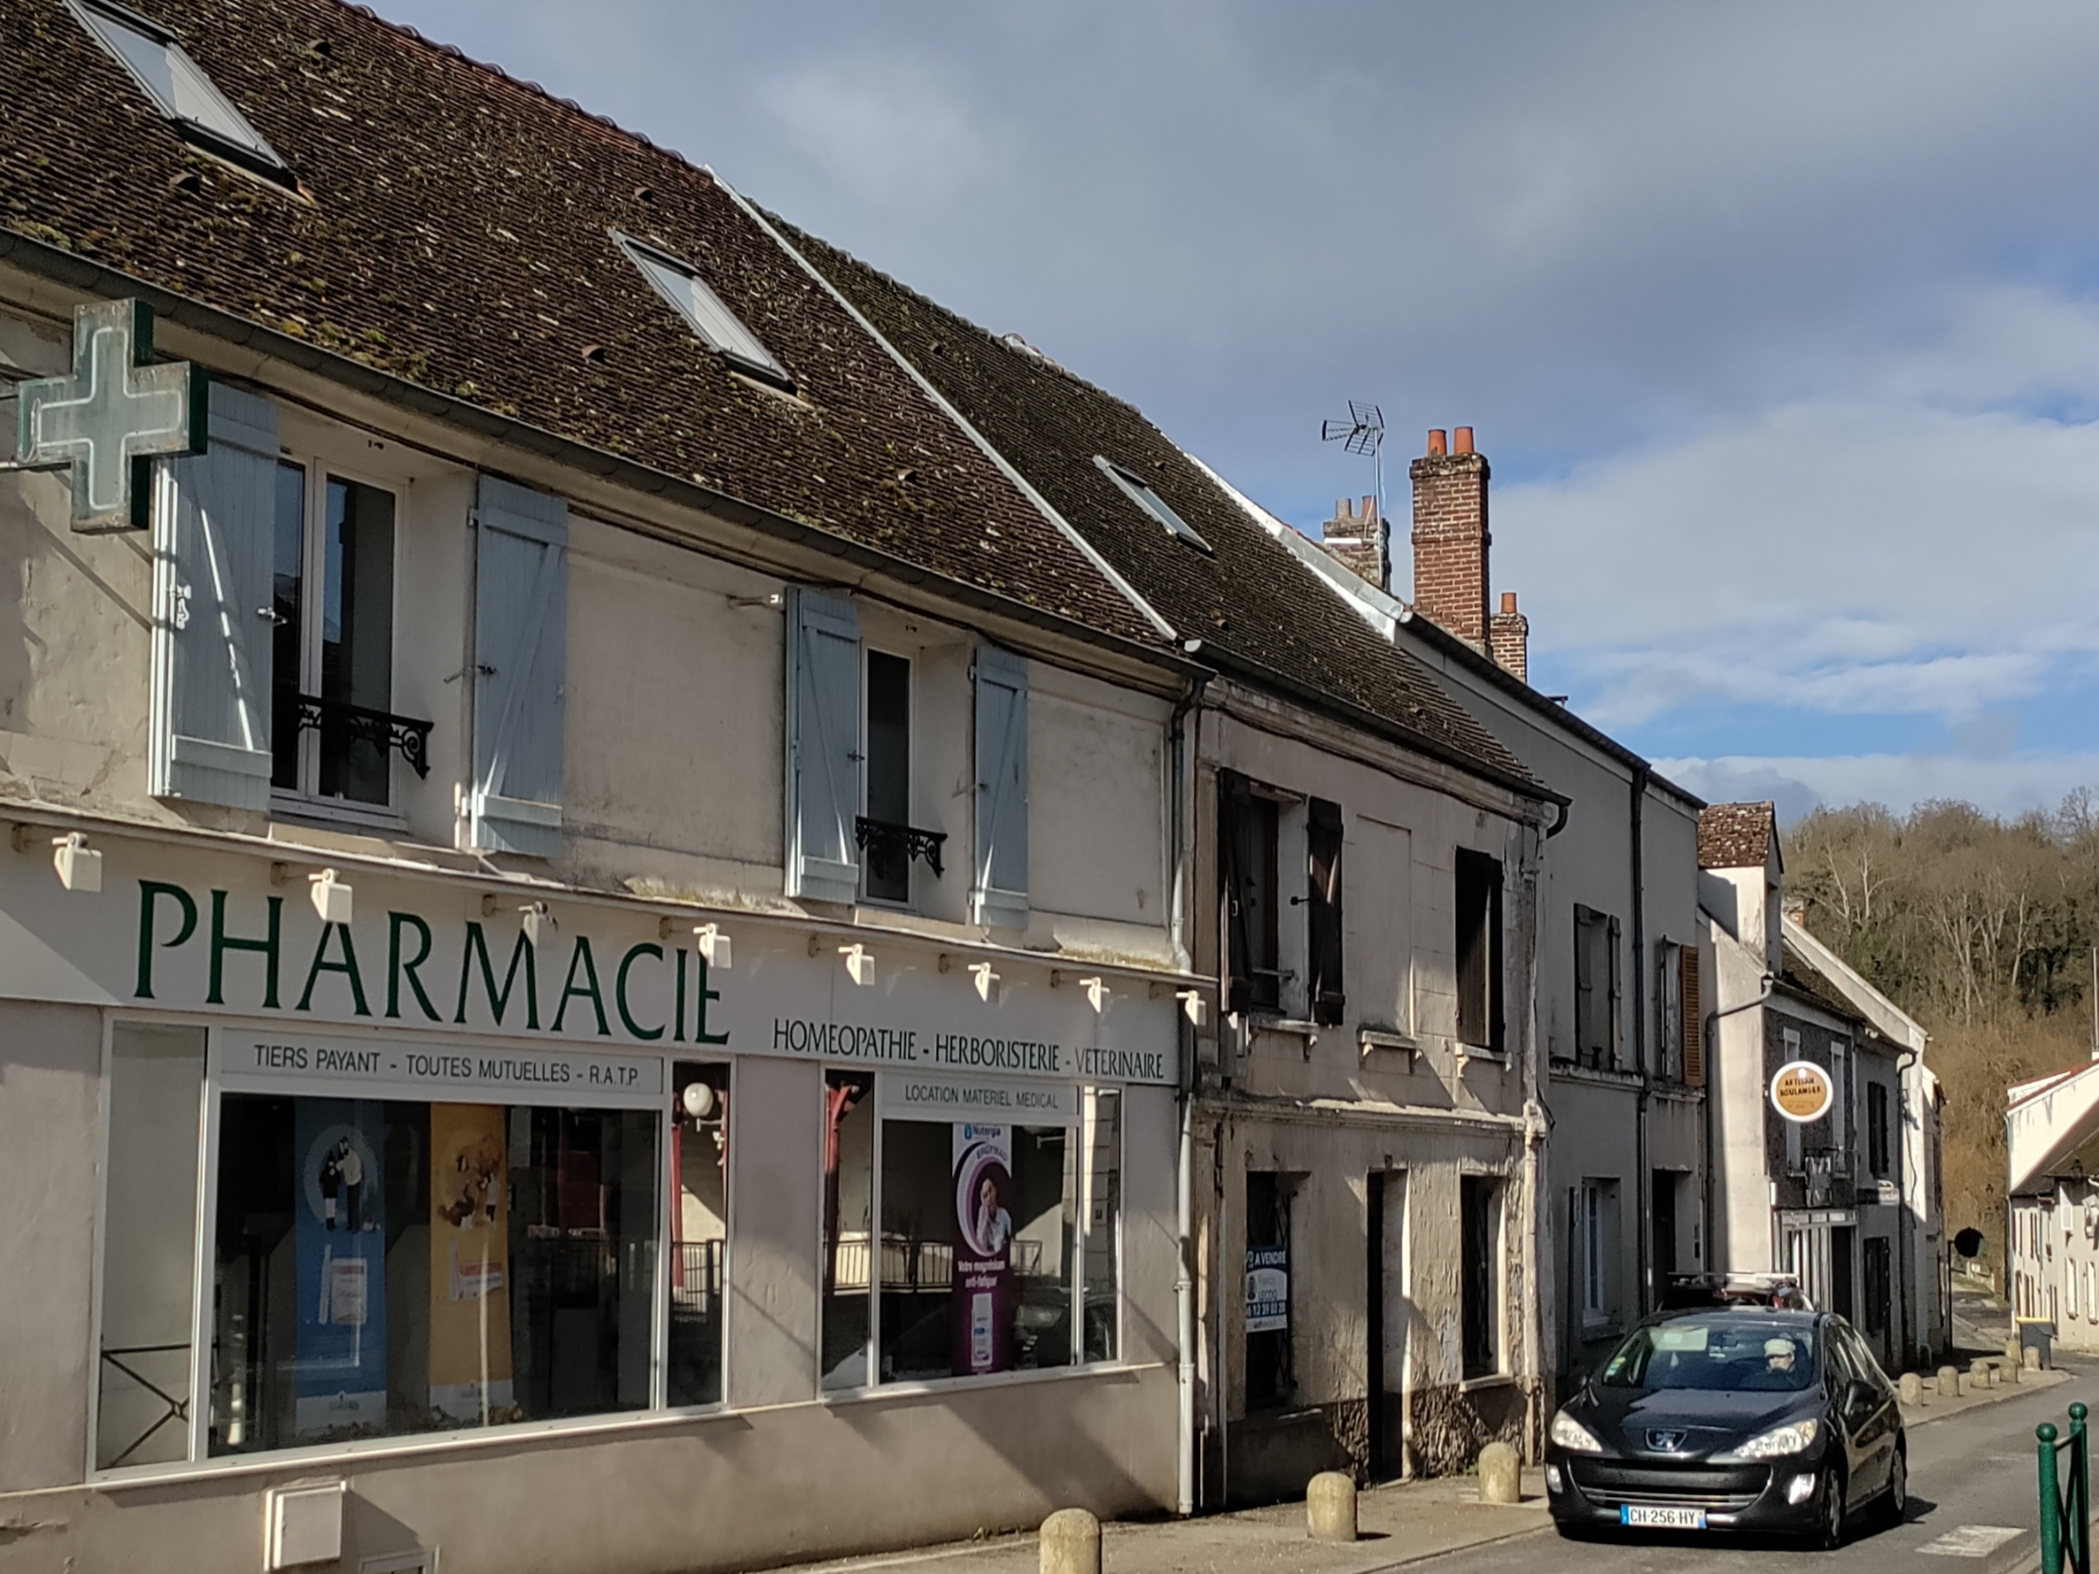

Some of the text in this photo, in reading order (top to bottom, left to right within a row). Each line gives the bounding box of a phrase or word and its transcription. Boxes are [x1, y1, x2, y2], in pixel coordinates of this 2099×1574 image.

[133, 879, 731, 1045] PHARMACIE
[773, 1018, 917, 1060] HOMEOPATHIE
[935, 1034, 1060, 1073] HERBORISTERIE
[1074, 1048, 1164, 1080] VETERINAIRE
[254, 1044, 308, 1069] TIERS
[316, 1049, 381, 1073] PAYANT
[406, 1054, 472, 1078] TOUTES
[478, 1058, 571, 1083] MUTUELLES
[1780, 1086, 1820, 1096] BOULANGER
[1785, 1078, 1814, 1086] ARTISAN
[905, 1084, 1059, 1110] LOCATION MATERIEL MEDICAL
[1261, 1251, 1286, 1265] VENDRE
